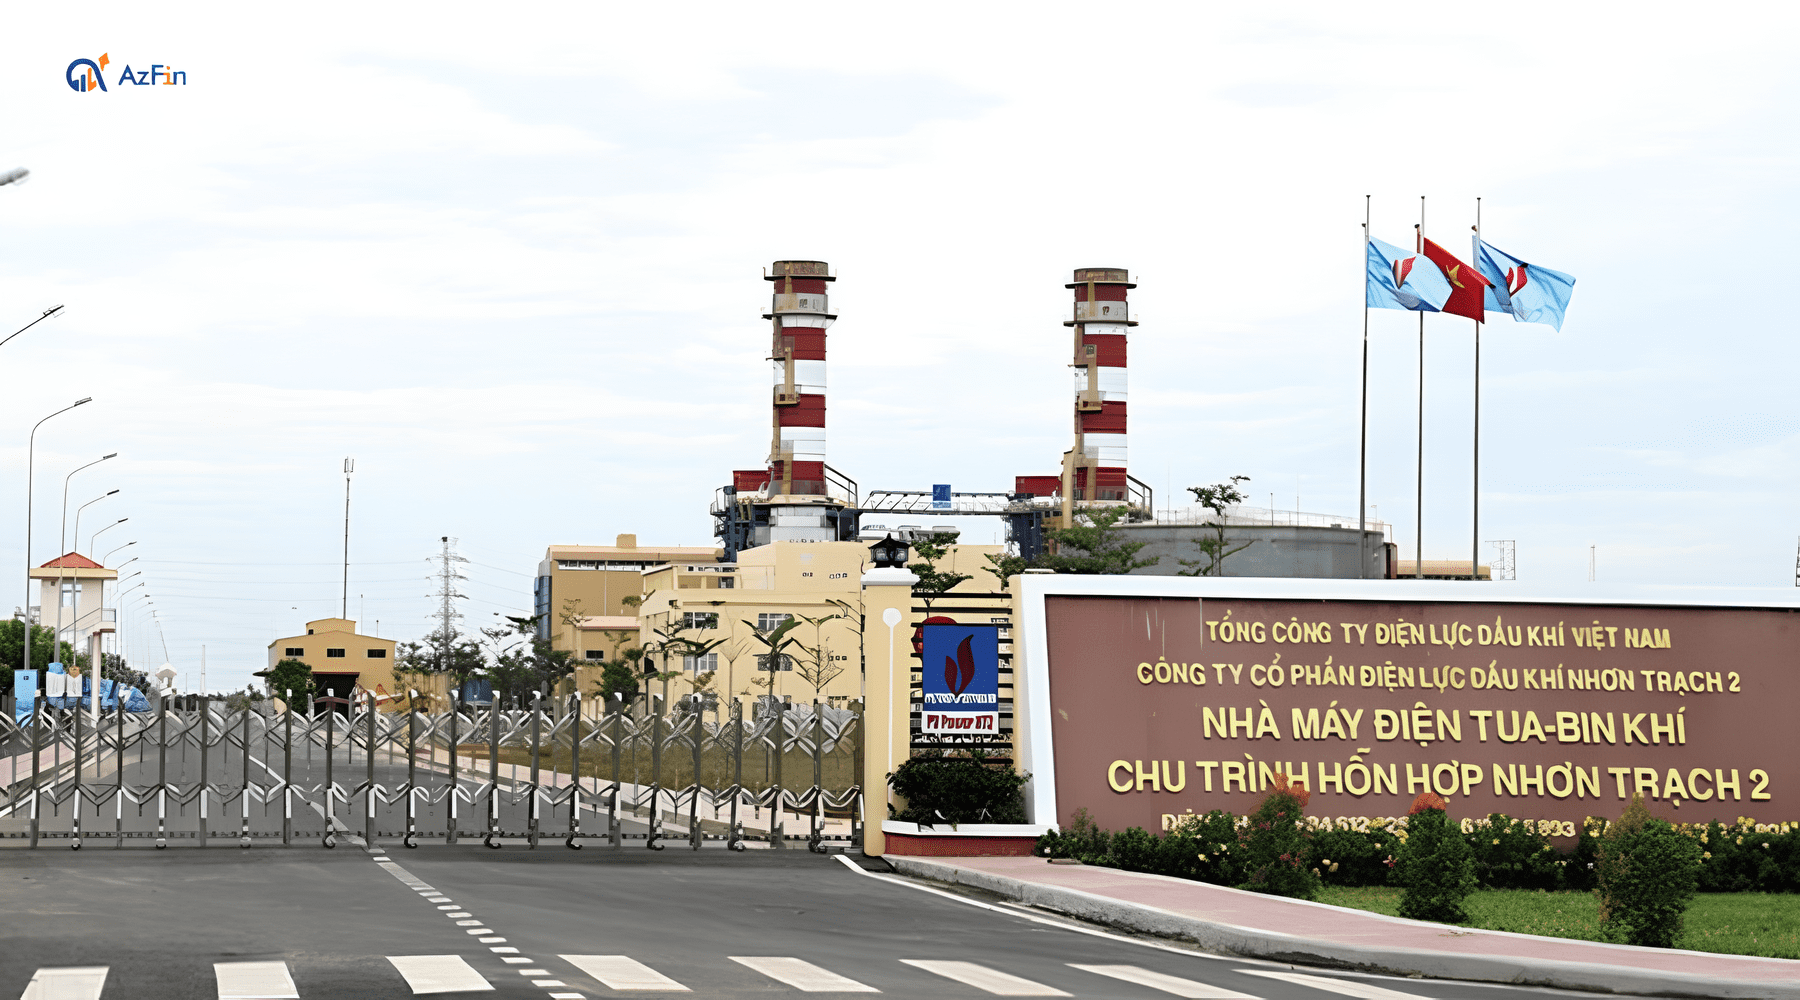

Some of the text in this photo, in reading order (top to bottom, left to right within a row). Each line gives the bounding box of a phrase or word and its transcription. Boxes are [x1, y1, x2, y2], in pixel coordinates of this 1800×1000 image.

[1272, 617, 1332, 643] CÔNG
[1340, 622, 1369, 645] TY
[1375, 618, 1426, 648] ĐIỆN
[1430, 621, 1474, 650] LỰC
[1527, 621, 1565, 647] KHÍ
[1571, 620, 1619, 651] VIỆT
[1624, 627, 1672, 648] NAM
[1136, 656, 1206, 685] CÔNG
[1211, 663, 1244, 685] TY
[1250, 652, 1285, 687] CỔ
[1360, 660, 1415, 693] ĐIỆN
[1418, 665, 1466, 694] LỰC
[1523, 663, 1564, 690] KHÍ
[1567, 667, 1635, 691] NHƠN
[1640, 670, 1724, 697] TRẠCH
[1727, 671, 1741, 692] 2
[1202, 698, 1686, 747] NHÀ MÁY ĐIỆN TUA-BIN KHÍ
[1107, 747, 1772, 807] CHU TRÌNH HỖN HỢP NHƠN TRẠCH 2
